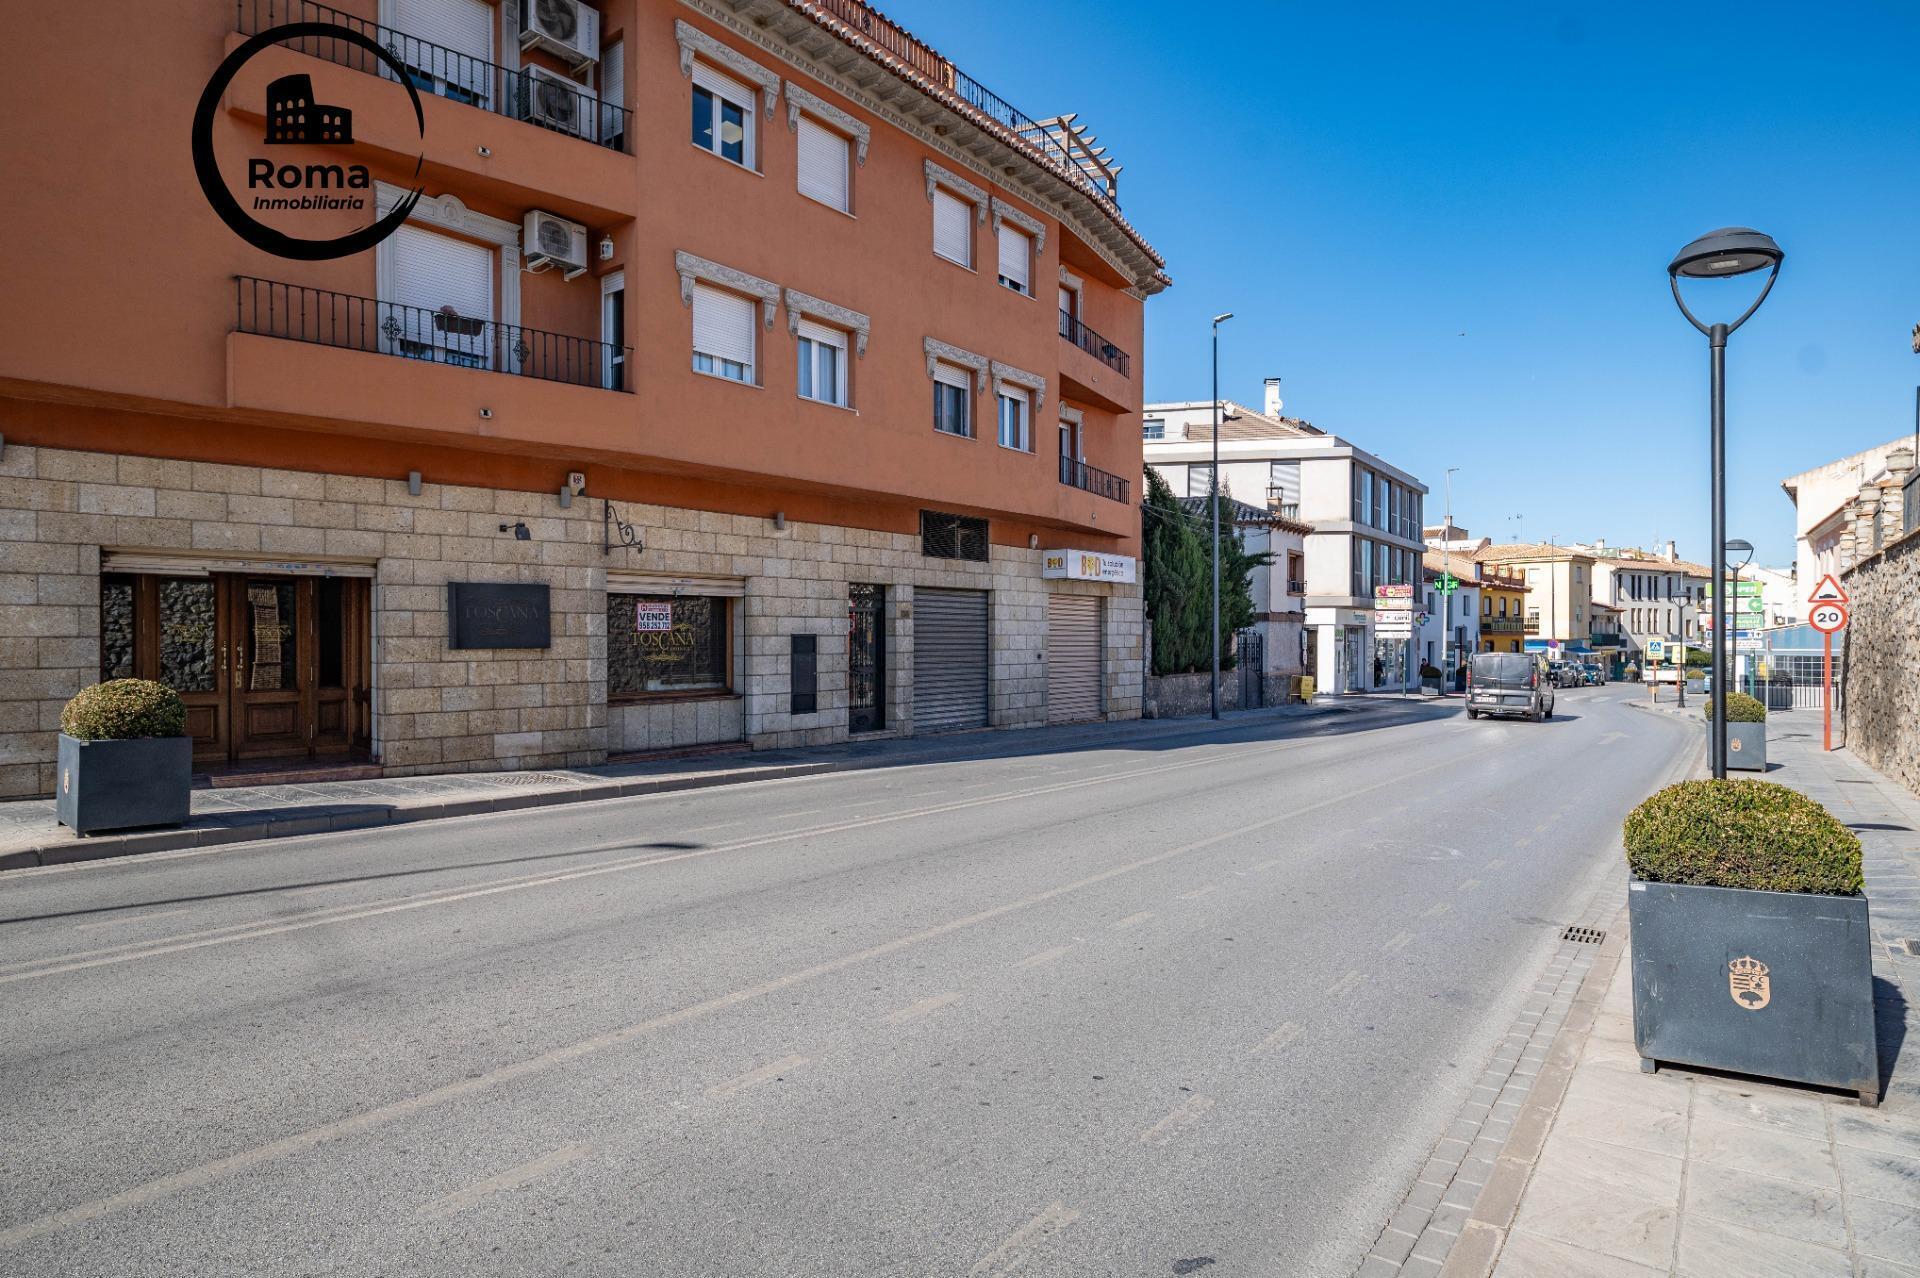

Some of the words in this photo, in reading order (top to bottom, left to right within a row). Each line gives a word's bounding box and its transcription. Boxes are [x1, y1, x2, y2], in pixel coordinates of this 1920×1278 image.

[639, 612, 670, 621] VENDE
[1817, 612, 1839, 623] 20
[630, 632, 694, 650] TOSCANA
